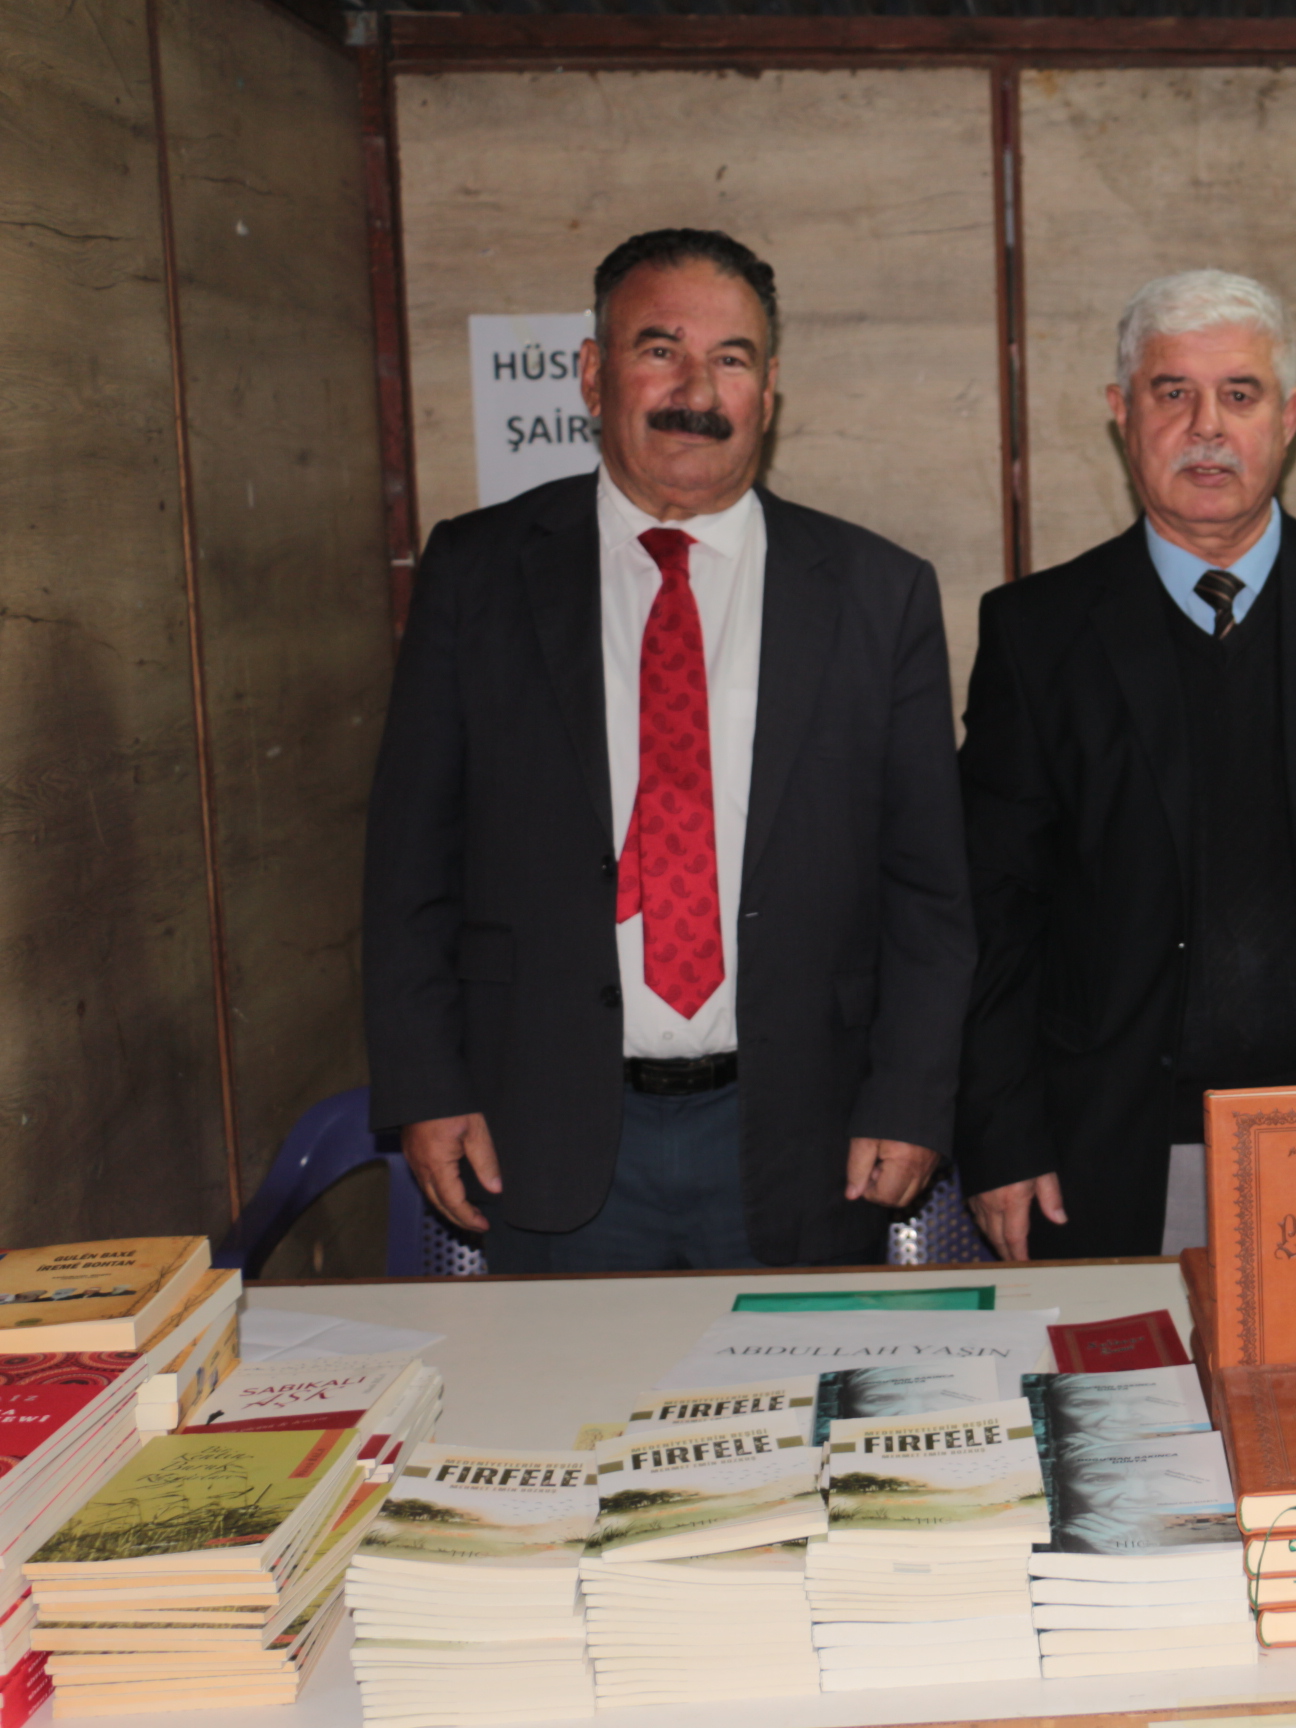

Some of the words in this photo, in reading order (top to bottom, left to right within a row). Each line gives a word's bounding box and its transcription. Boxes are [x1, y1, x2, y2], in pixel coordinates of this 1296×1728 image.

[715, 1345, 900, 1356] ABDULLAH
[239, 1376, 367, 1397] SABIKALI
[659, 1395, 786, 1420] FIRFELE
[864, 1425, 1002, 1453] FIRFELE
[631, 1435, 773, 1470] FIRFELE
[435, 1465, 582, 1487] FIRFELE
